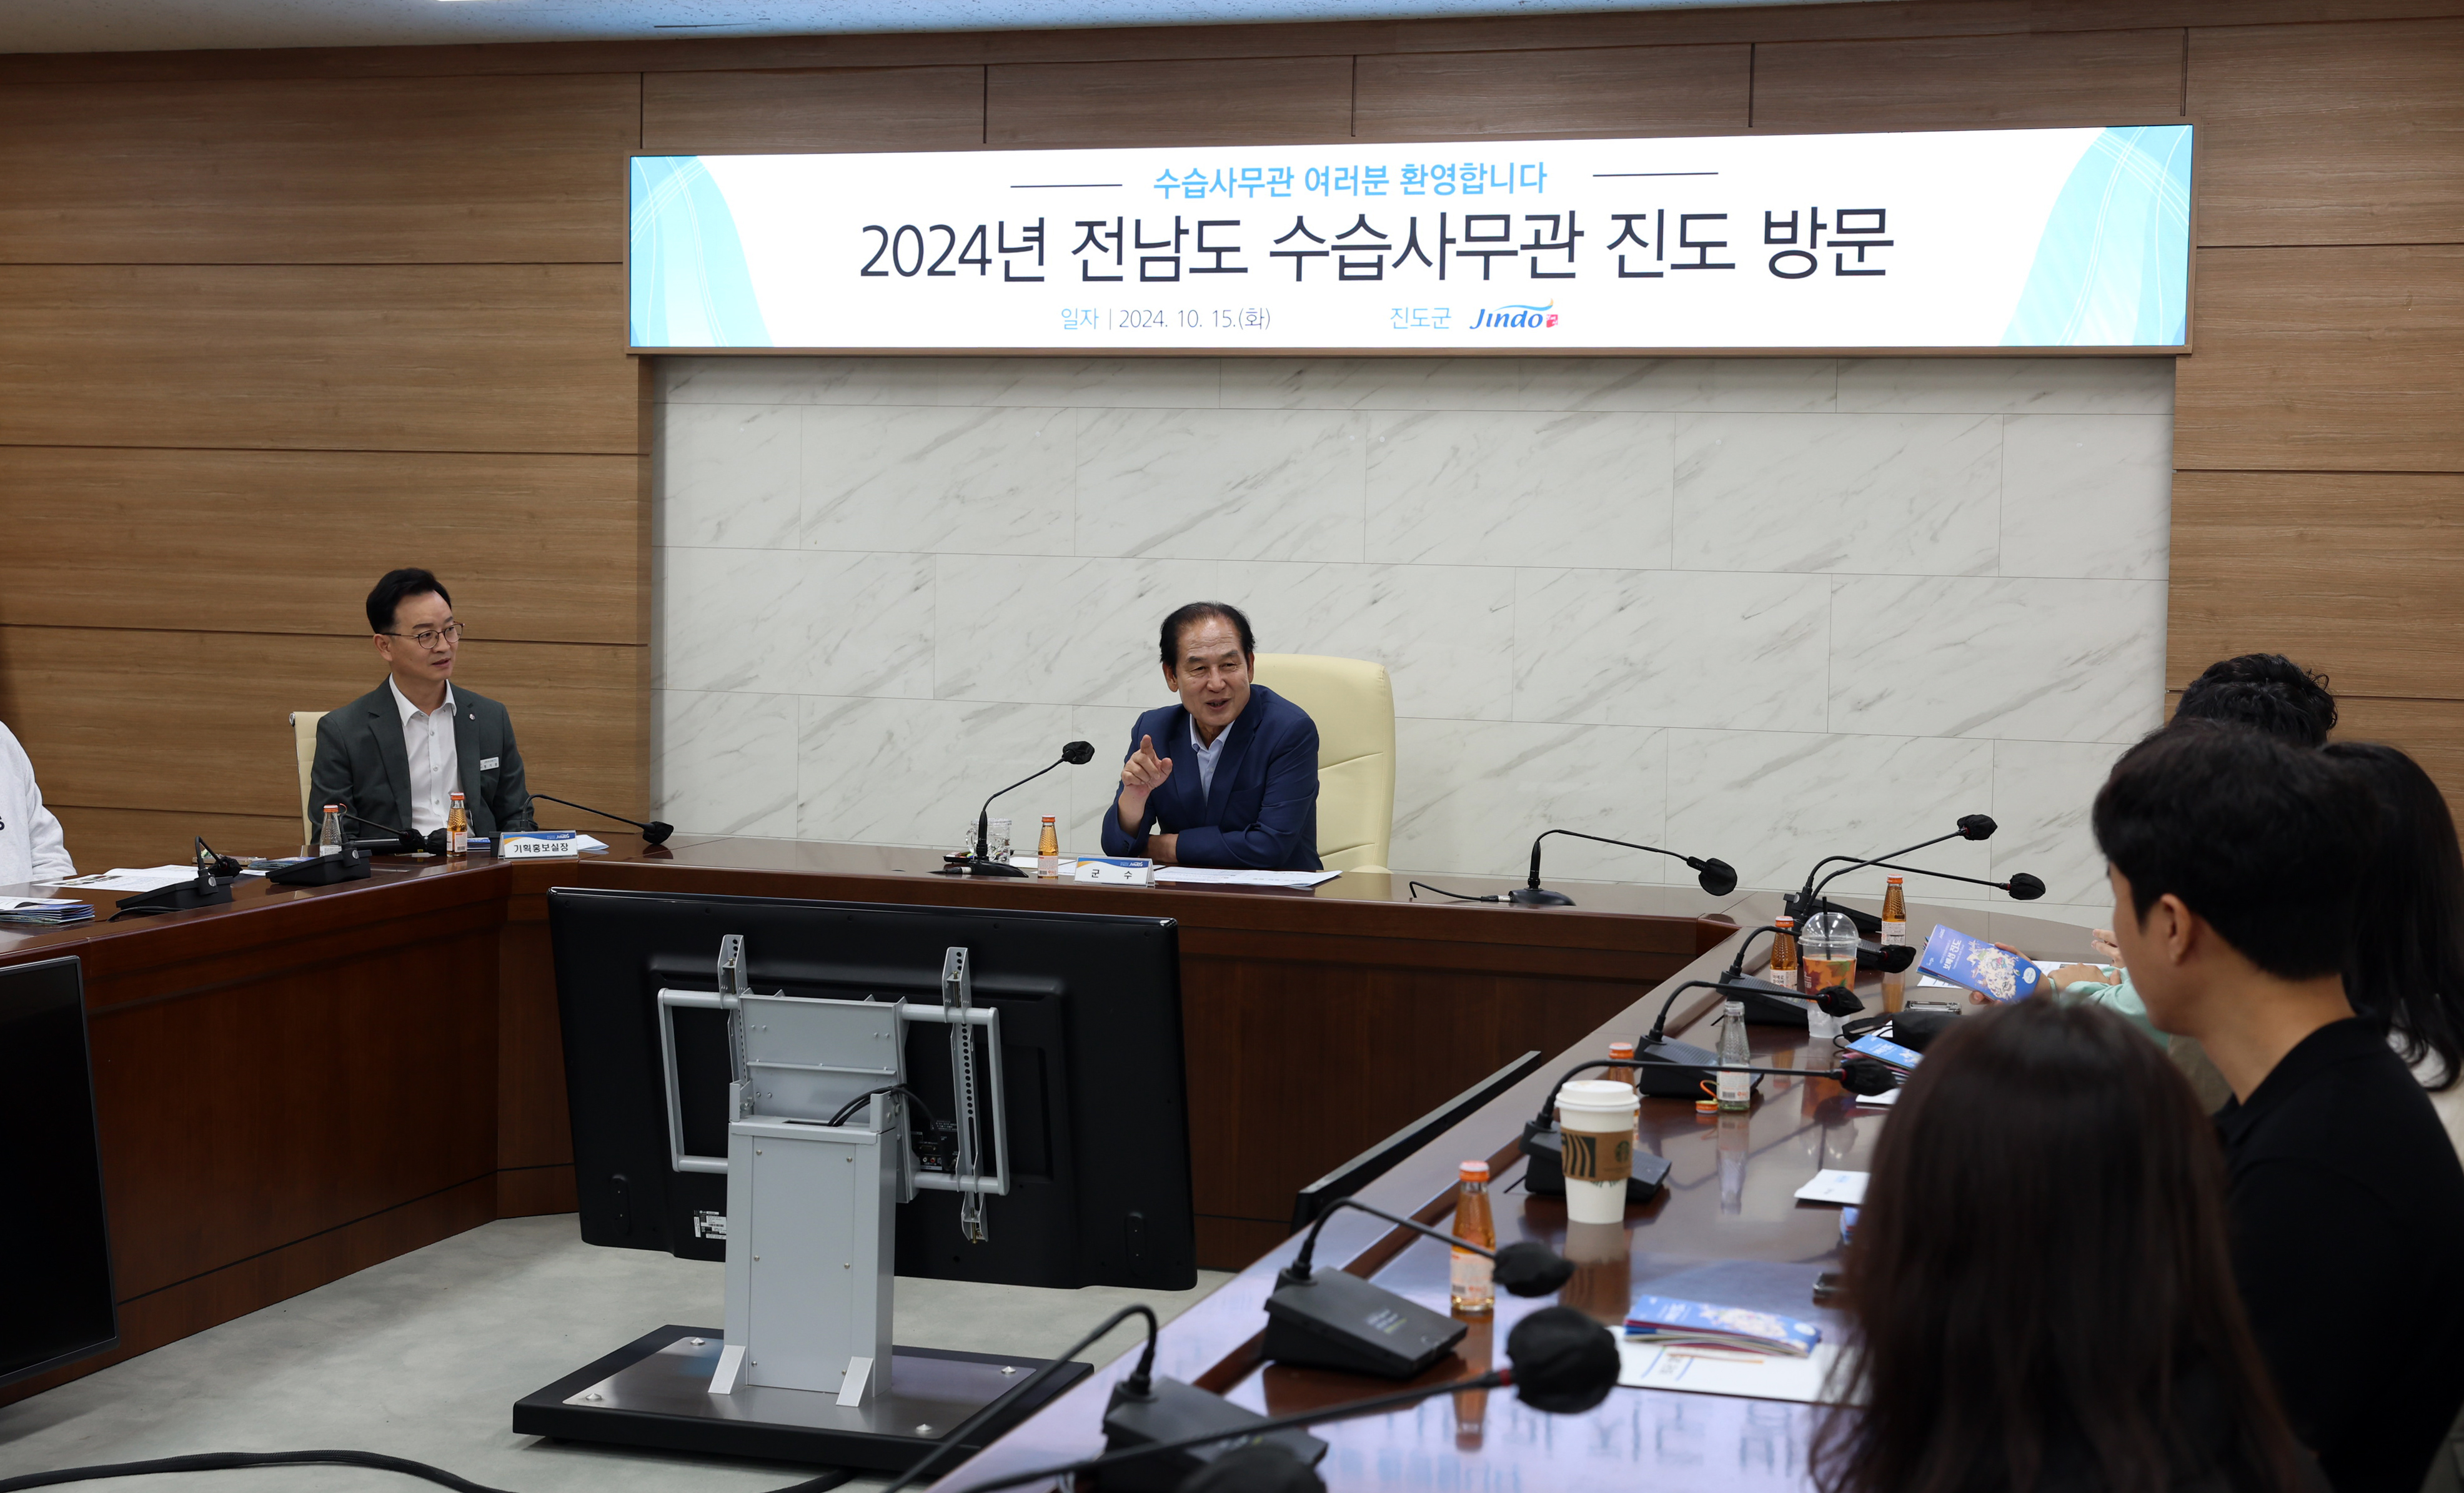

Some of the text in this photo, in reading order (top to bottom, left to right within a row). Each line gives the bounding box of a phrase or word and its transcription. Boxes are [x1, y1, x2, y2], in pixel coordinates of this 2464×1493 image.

[1154, 161, 1548, 200] 수습사무관 여러분 환영합니다
[861, 206, 1895, 282] 2024년 전남도 수습사무관 진도 방문
[1061, 307, 1270, 330] 일자 2024. 10. 15.(화)
[1390, 307, 1452, 330] 진도군
[1469, 307, 1544, 329] Jindo
[514, 843, 569, 853] 기획홍보실장
